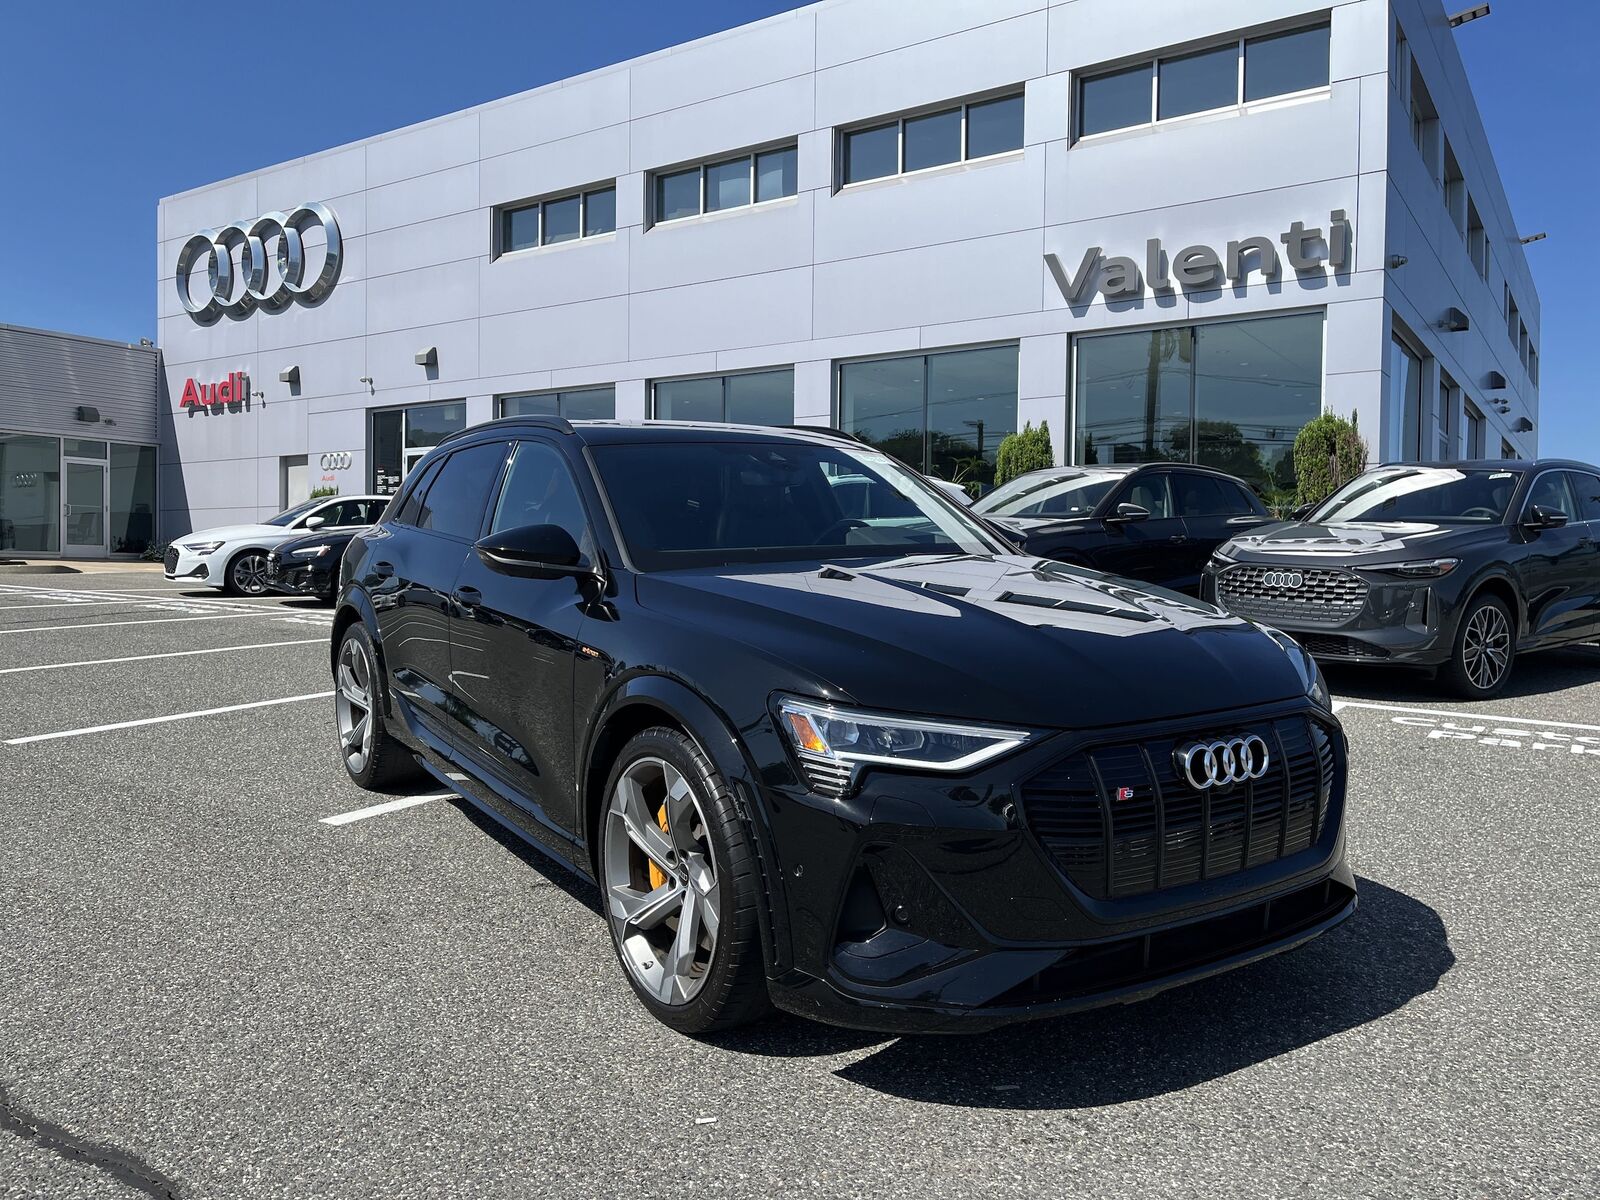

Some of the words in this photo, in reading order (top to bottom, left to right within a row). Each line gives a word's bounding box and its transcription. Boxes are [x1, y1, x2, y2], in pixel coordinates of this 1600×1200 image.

[1043, 209, 1347, 301] Valenti
[179, 371, 244, 408] Audi
[320, 474, 337, 482] Audi
